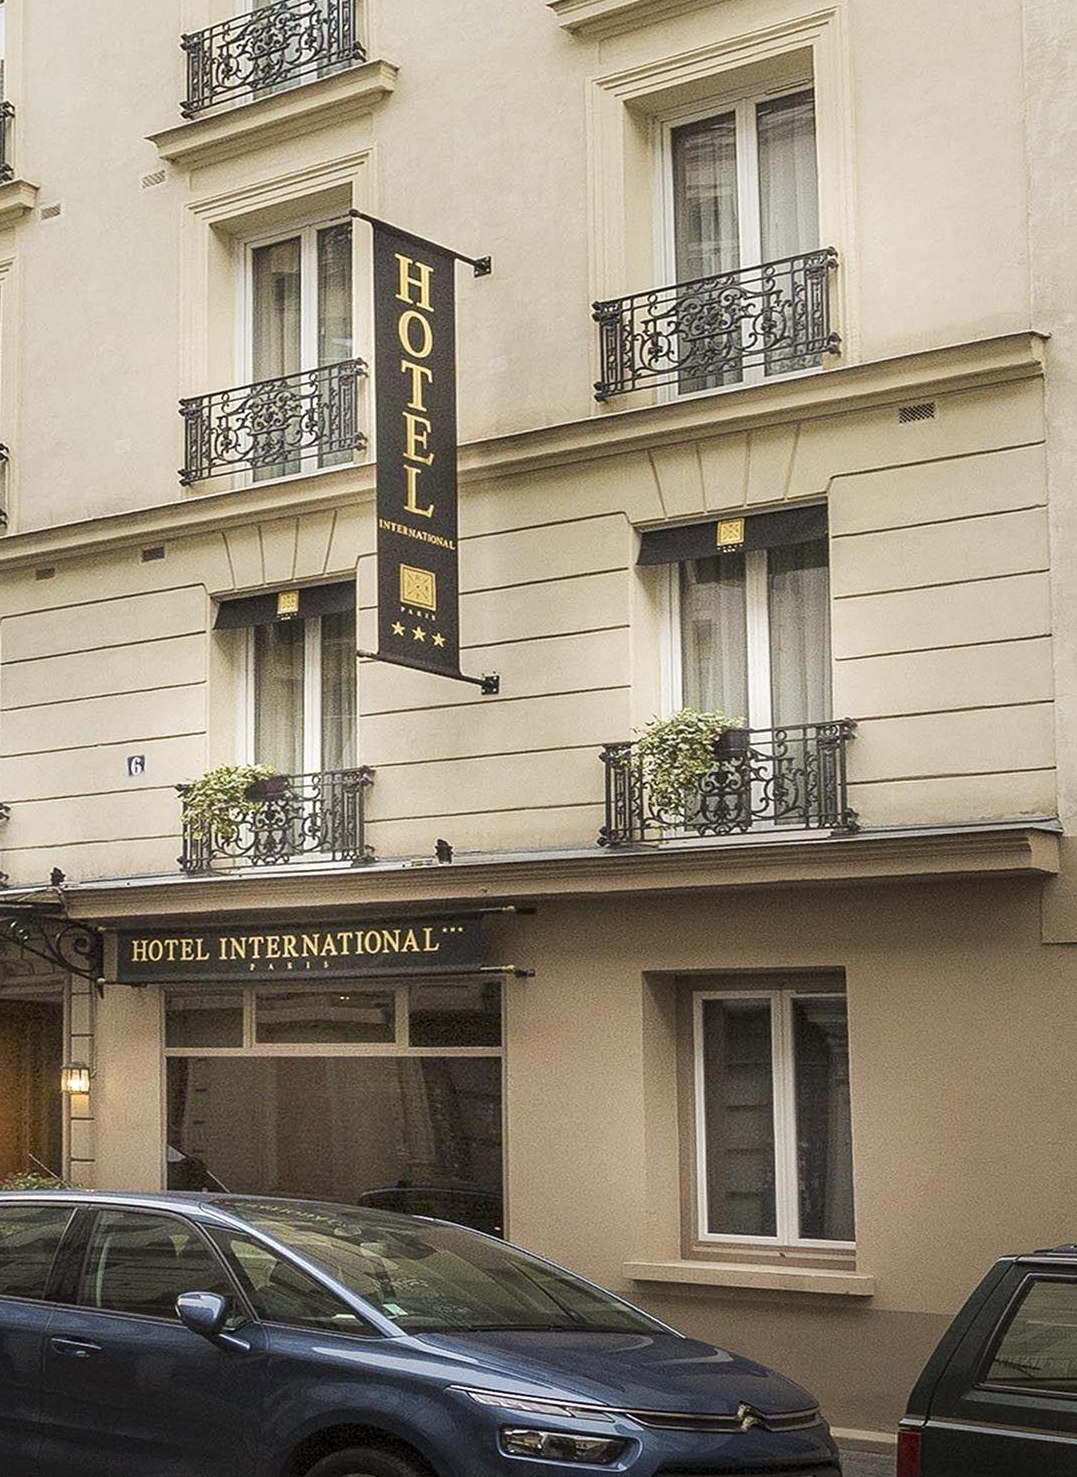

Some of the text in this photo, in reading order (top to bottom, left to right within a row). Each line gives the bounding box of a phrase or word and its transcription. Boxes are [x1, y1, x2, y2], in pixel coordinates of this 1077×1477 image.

[394, 253, 435, 518] HOTEL
[378, 518, 457, 550] INTERNATIONAL
[131, 756, 143, 776] 6
[131, 927, 440, 962] HOTEL INTERNATIONAL
[249, 960, 329, 972] PARIS
